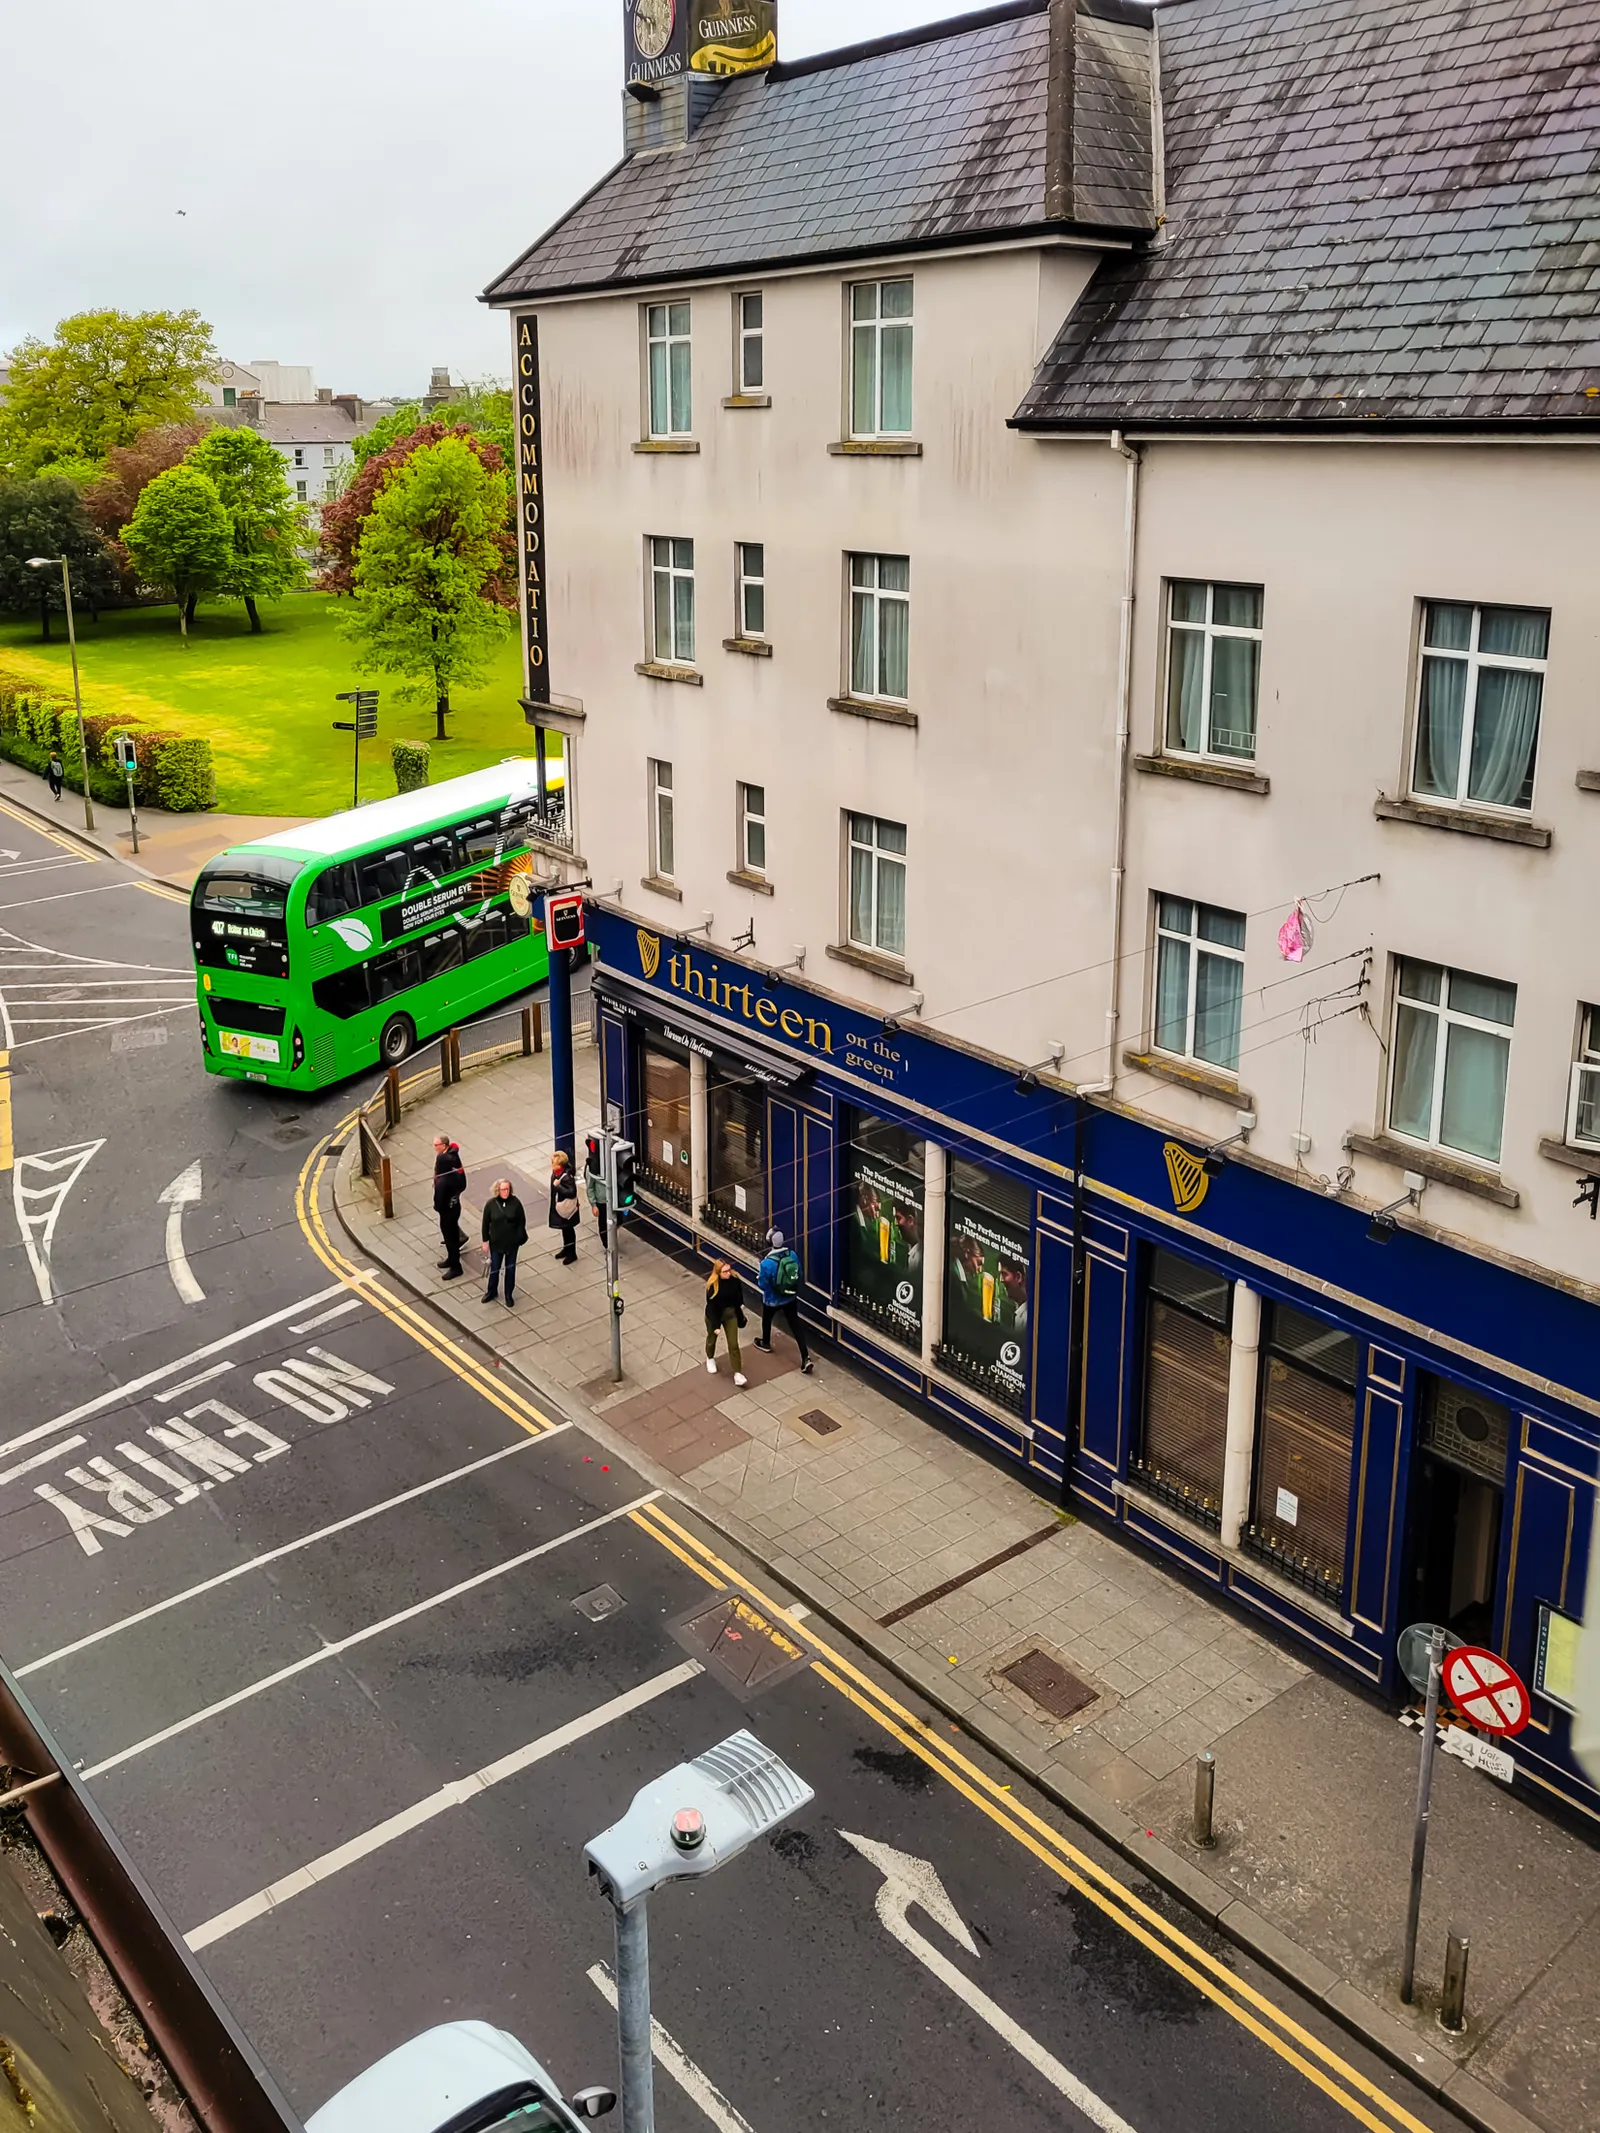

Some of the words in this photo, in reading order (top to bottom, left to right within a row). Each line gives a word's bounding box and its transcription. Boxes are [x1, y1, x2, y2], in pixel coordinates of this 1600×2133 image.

[699, 15, 757, 38] GUINNESS
[630, 52, 681, 81] GUINNESS
[519, 322, 543, 666] ACCOMMODATIO
[402, 898, 432, 918] DOUBLE
[433, 888, 457, 905] SERUM
[458, 882, 472, 895] EYE
[403, 914, 420, 925] DOUBLE
[420, 908, 434, 918] SERUM
[434, 902, 449, 912] DOUBLE
[212, 921, 224, 934] 407
[227, 953, 237, 961] TFI
[667, 954, 835, 1055] thirteen
[846, 1033, 867, 1049] on
[873, 1042, 900, 1062] the
[846, 1052, 894, 1080] green
[861, 1173, 886, 1192] Thirteen
[886, 1188, 894, 1196] on
[895, 1191, 904, 1201] the
[905, 1197, 923, 1211] green
[863, 1165, 874, 1177] The
[874, 1171, 895, 1188] Perfect
[896, 1182, 914, 1198] Match
[954, 1223, 962, 1231] at
[962, 1225, 990, 1246] Thirteen
[991, 1242, 1000, 1251] on
[1000, 1245, 1012, 1257] the
[964, 1217, 977, 1230] The
[977, 1223, 1001, 1242] Perfect
[1002, 1236, 1022, 1253] Match
[252, 1346, 396, 1424] NO
[33, 1399, 291, 1556] ENTRY
[1452, 1734, 1474, 1757] 24
[1480, 1747, 1499, 1761] Uair
